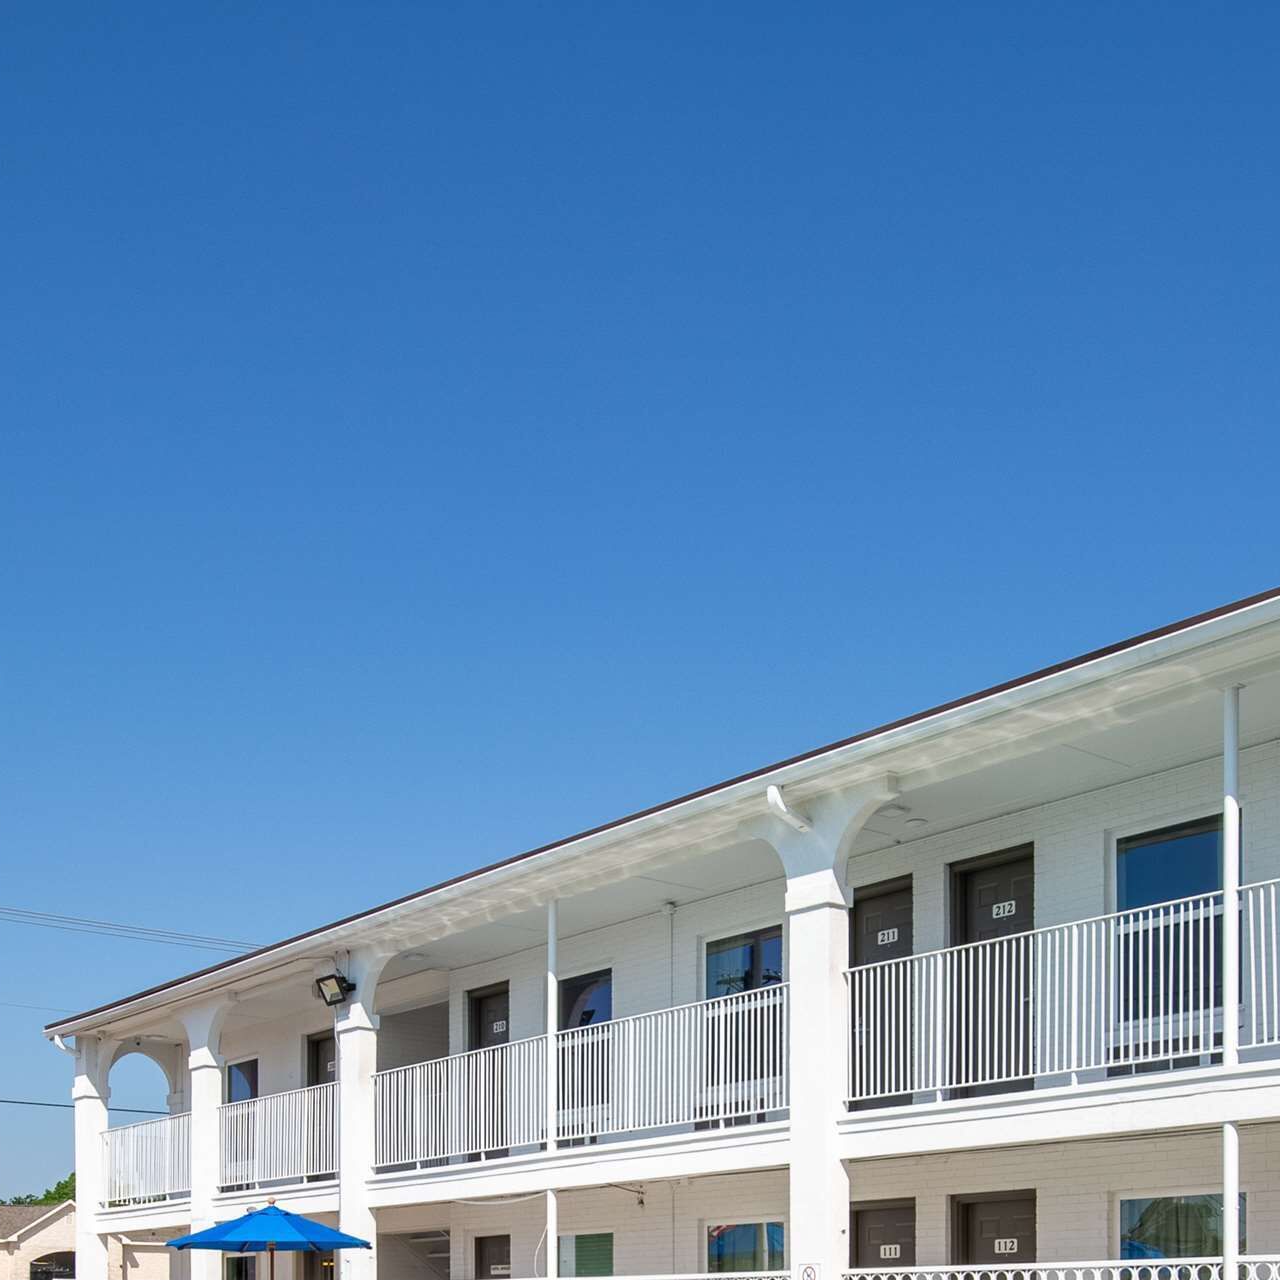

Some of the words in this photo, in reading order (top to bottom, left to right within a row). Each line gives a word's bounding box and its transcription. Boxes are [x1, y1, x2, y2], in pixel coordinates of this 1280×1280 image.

[995, 903, 1013, 916] 212
[880, 930, 896, 942] 211
[997, 1240, 1015, 1251] 112
[883, 1246, 898, 1257] 111
